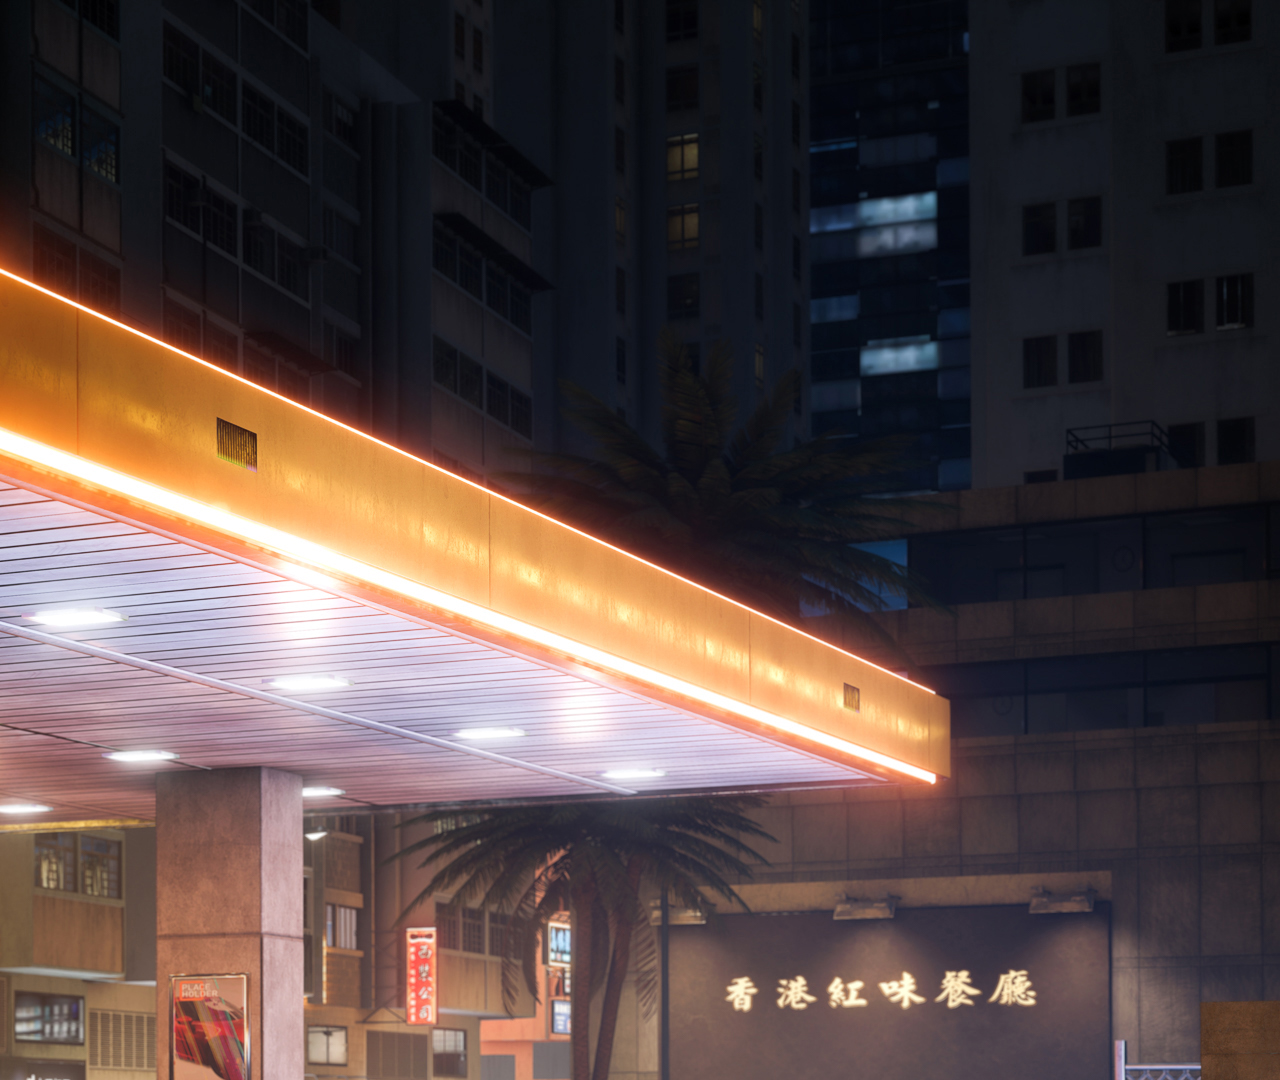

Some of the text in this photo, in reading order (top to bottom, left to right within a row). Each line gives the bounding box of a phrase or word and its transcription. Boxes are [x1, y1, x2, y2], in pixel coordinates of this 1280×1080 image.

[182, 983, 211, 991] PLACE
[726, 969, 1037, 1012] 香港紅味餐廳
[182, 990, 218, 998] HOLDER
